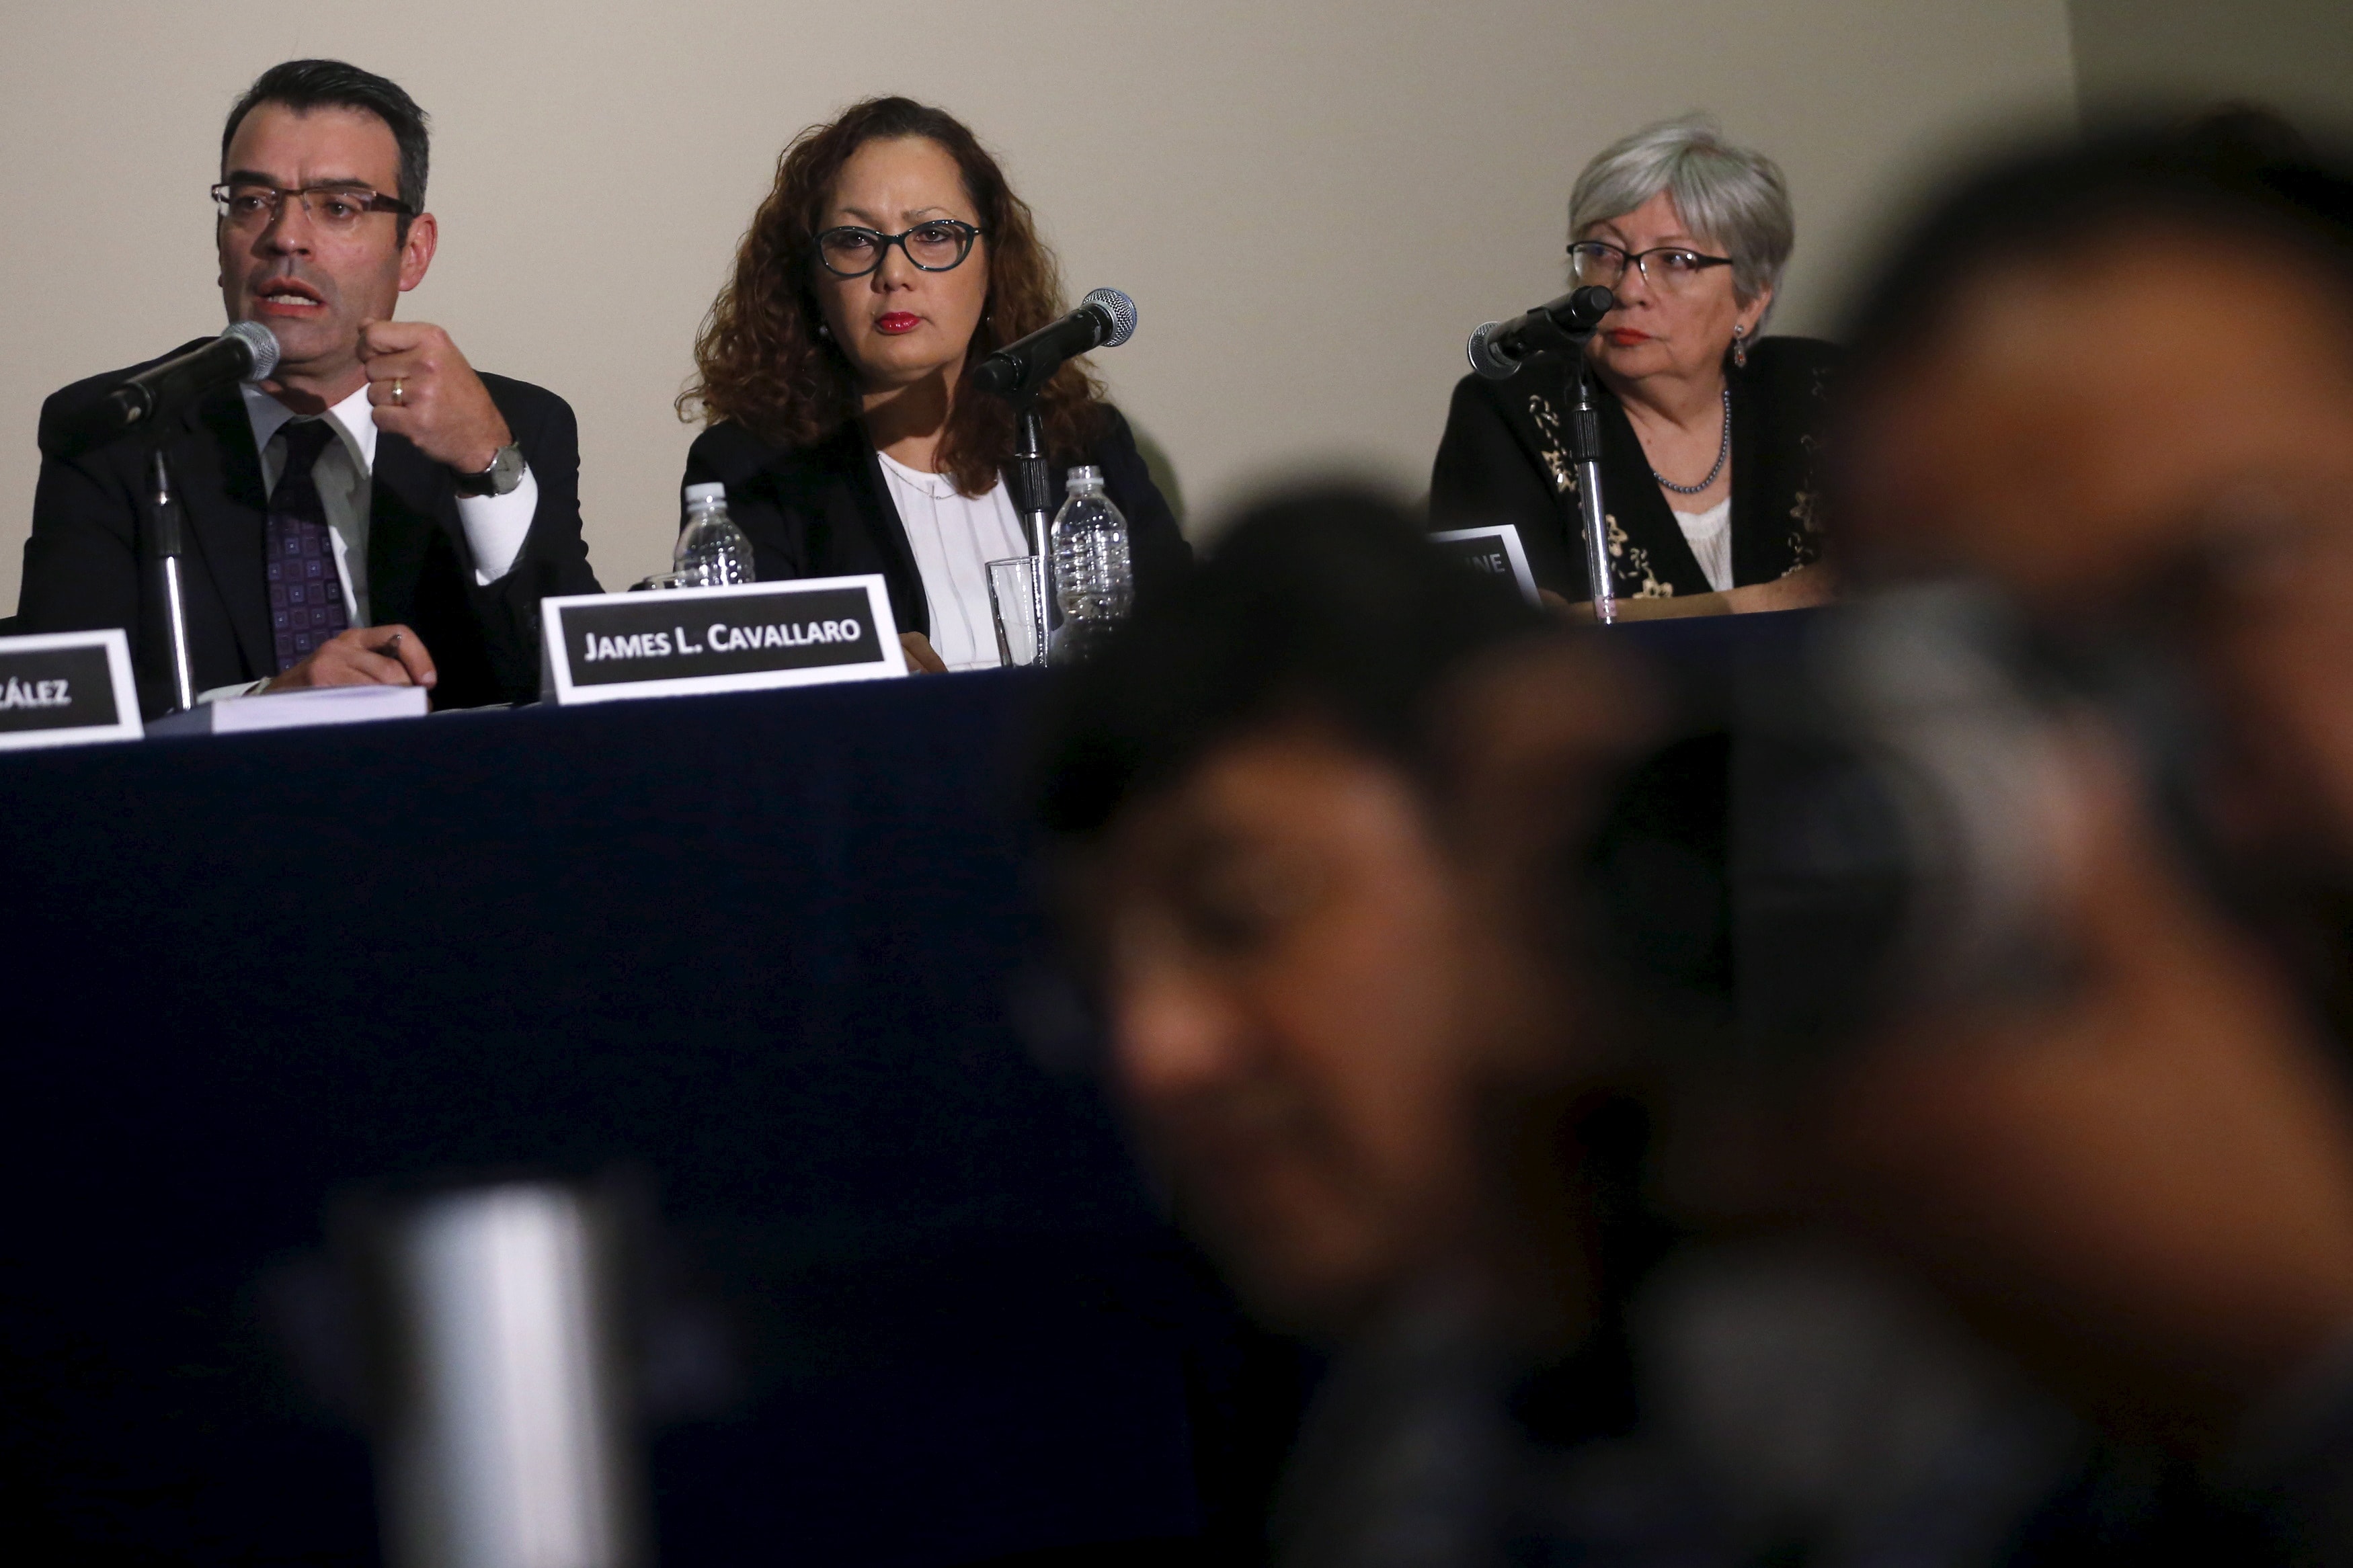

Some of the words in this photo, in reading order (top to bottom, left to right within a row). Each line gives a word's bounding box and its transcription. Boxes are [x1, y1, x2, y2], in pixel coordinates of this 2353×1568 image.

[584, 632, 672, 662] JAMES
[674, 626, 703, 655] L.
[707, 618, 861, 652] CAVALLARO
